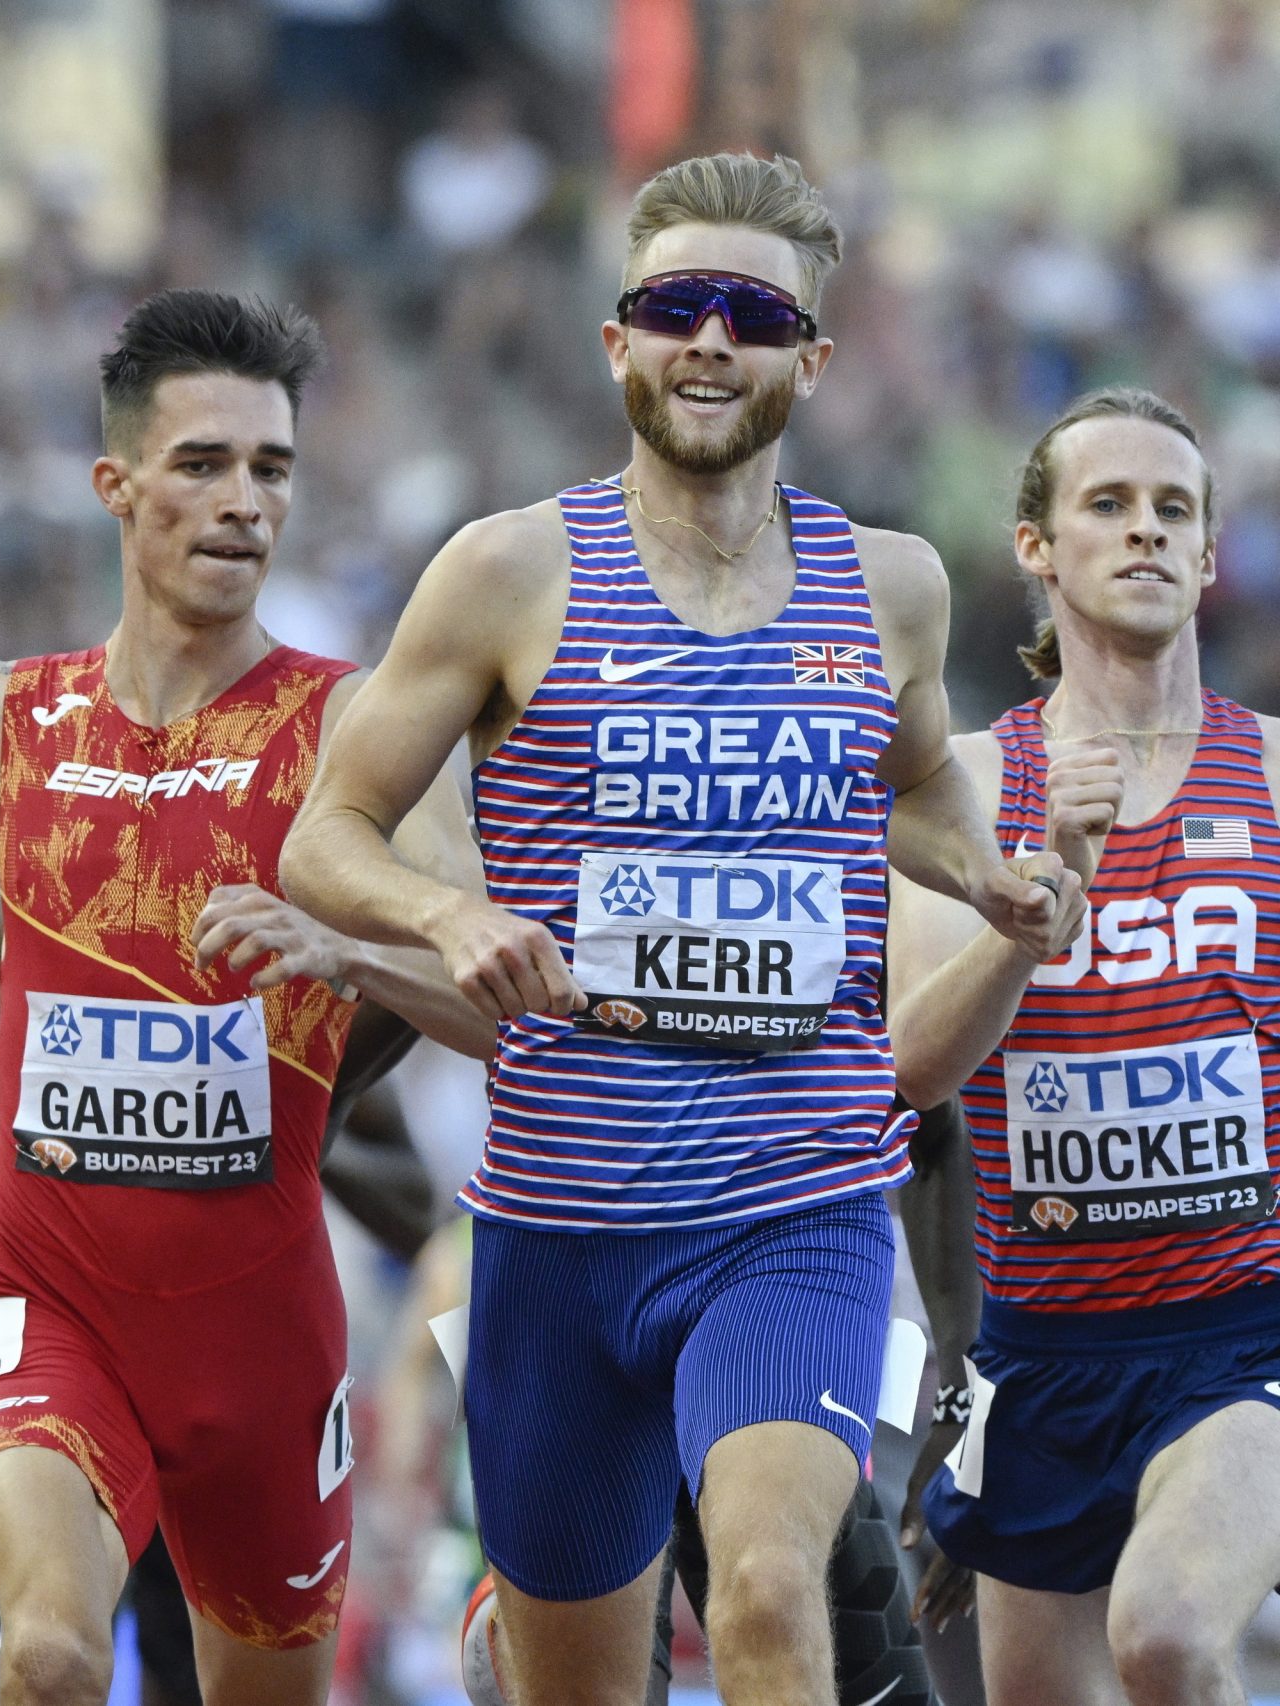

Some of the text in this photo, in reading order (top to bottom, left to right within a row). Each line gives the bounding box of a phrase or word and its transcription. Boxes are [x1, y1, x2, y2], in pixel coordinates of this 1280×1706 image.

[596, 716, 857, 764] GREAT
[45, 757, 261, 804] ESPAÑA
[593, 773, 853, 821] BRITAIN
[656, 865, 830, 924] TDK
[634, 934, 794, 996] KERR
[82, 1006, 250, 1065] TDK
[656, 1011, 800, 1037] BUDAPEST
[1065, 1045, 1246, 1113] TDK
[40, 1080, 251, 1139] GARCÍA
[84, 1151, 258, 1175] BUDAPEST 23
[1022, 1114, 1250, 1185] HOCKER
[1086, 1186, 1260, 1223] BUDAPEST 23
